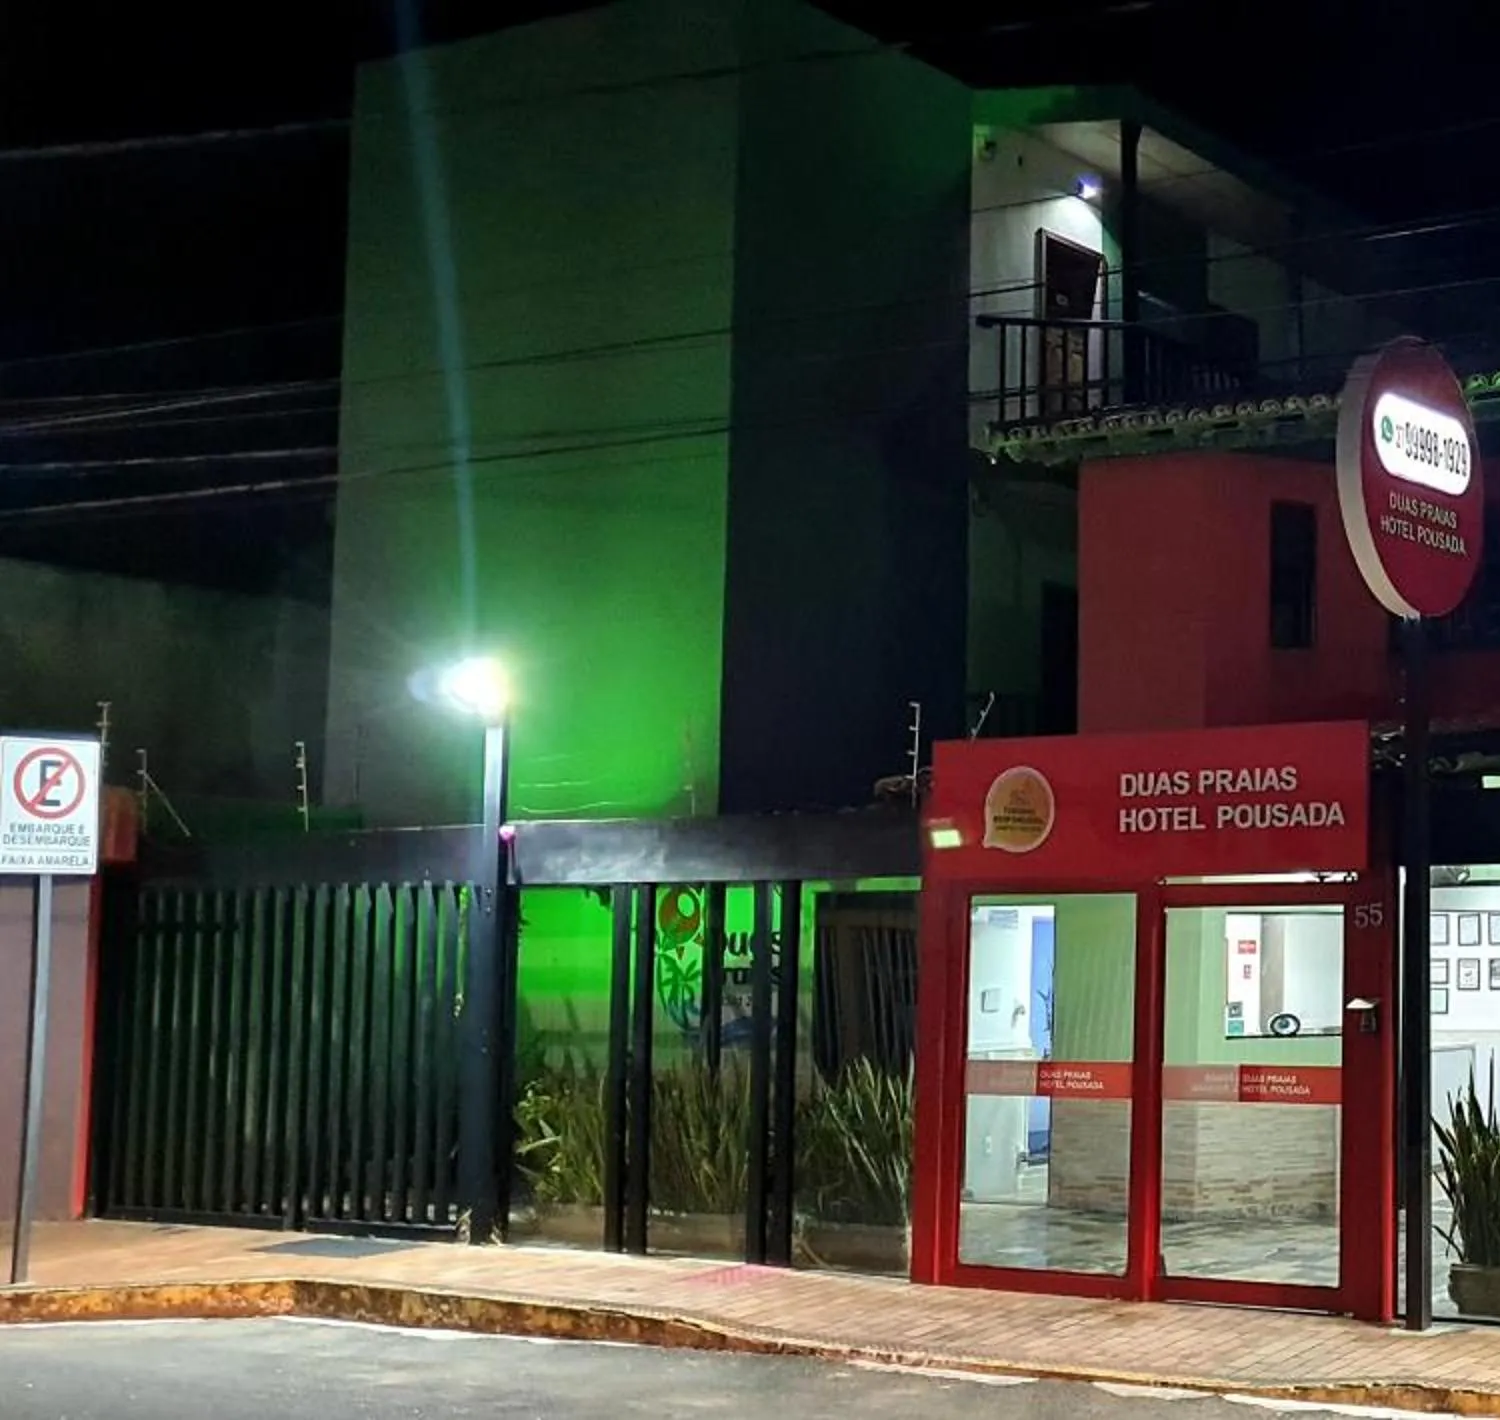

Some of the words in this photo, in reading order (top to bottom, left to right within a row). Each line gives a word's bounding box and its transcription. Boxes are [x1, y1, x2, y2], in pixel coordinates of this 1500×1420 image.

[1389, 490, 1417, 517] DUAS
[1420, 501, 1457, 529] PRAIAS
[1380, 514, 1416, 541] HOTEL
[1417, 525, 1469, 558] POUSADA
[1120, 771, 1190, 797] DUAS
[1198, 766, 1297, 794] PRAIAS
[1119, 806, 1206, 832] HOTEL
[1217, 801, 1345, 829] POUSADA
[9, 822, 76, 835] EMBARQUE
[3, 833, 91, 847] DESEMBARQUE
[2, 855, 34, 865] FAIXA
[38, 855, 89, 866] AMARELA
[1355, 902, 1383, 928] 55
[1063, 1070, 1092, 1080] PRAIAS
[1066, 1081, 1104, 1090] POUSADA
[1269, 1085, 1311, 1096] POUSADA
